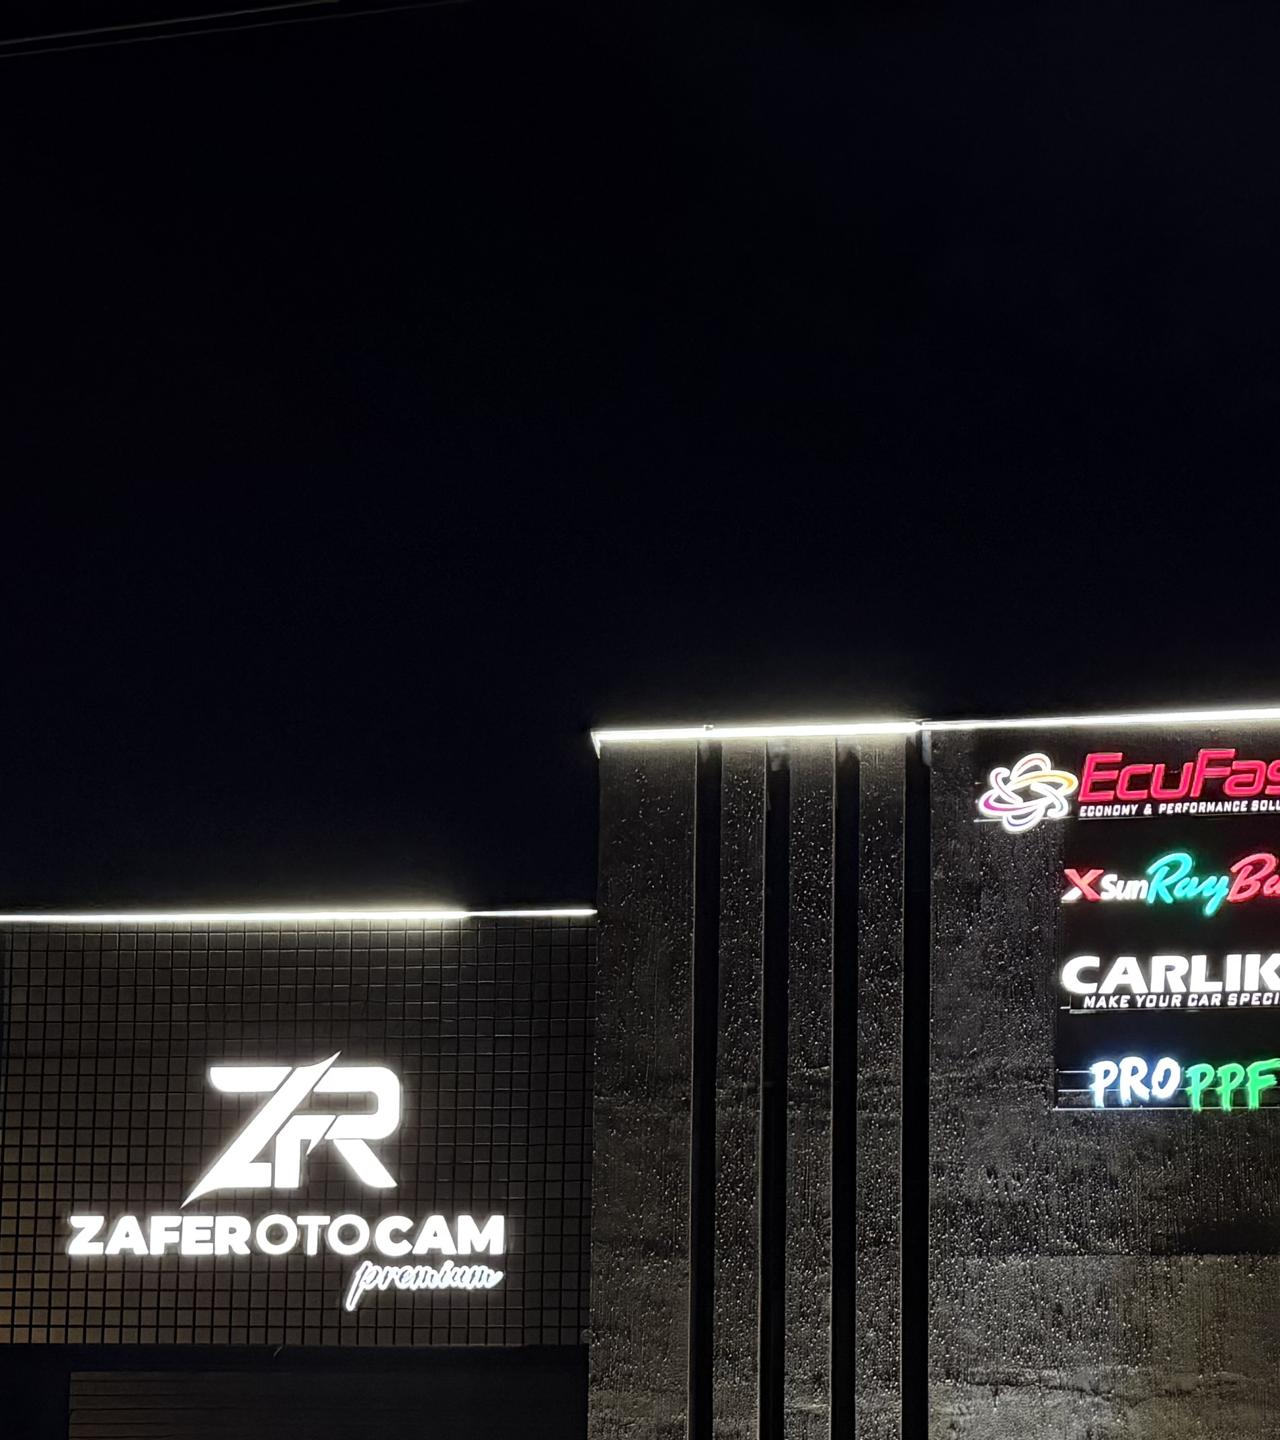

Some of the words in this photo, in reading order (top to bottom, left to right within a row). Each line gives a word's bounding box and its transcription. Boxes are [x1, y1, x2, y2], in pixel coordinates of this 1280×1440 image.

[1079, 803, 1138, 818] ECONOMY
[1143, 802, 1152, 815] &
[1158, 800, 1249, 815] PERFORMANCE
[1083, 995, 1131, 1009] MAKE
[1135, 994, 1182, 1008] YOUR
[1187, 993, 1222, 1007] CAR
[345, 1260, 505, 1312] premium
